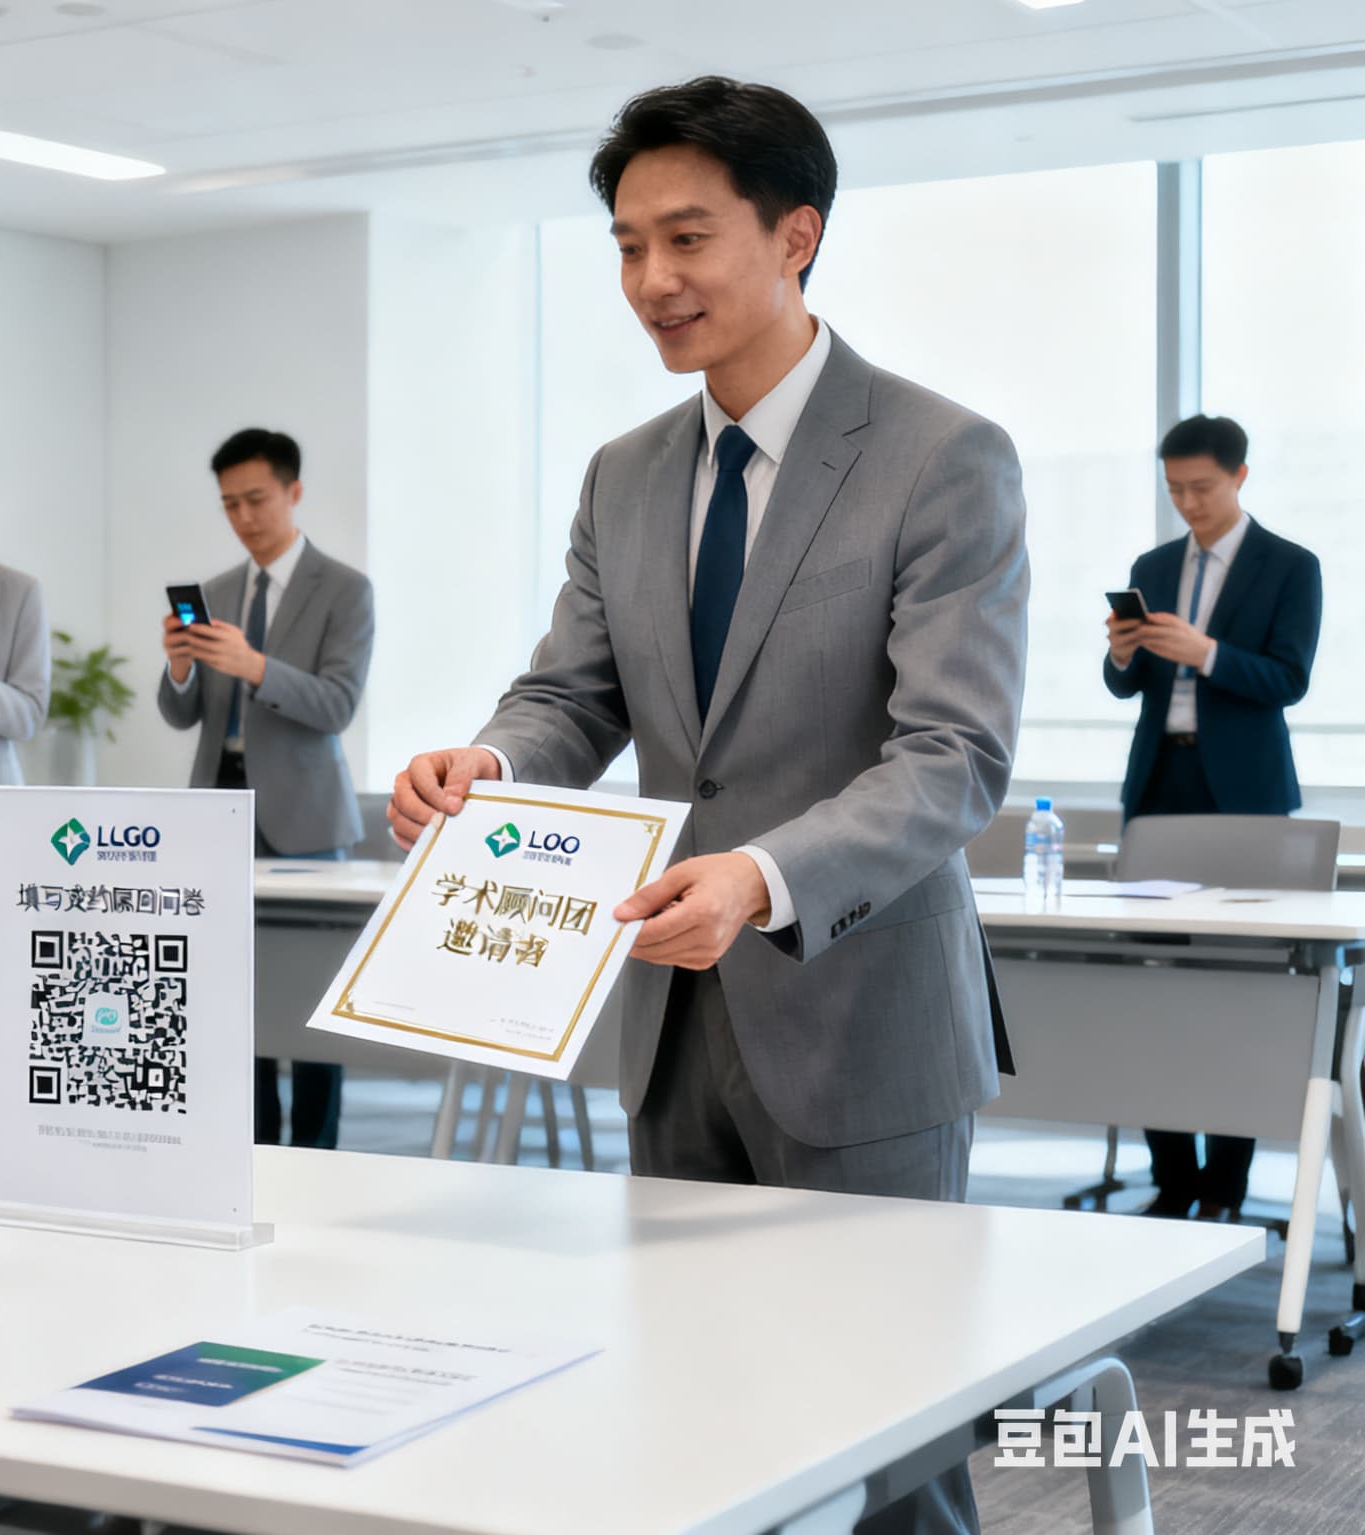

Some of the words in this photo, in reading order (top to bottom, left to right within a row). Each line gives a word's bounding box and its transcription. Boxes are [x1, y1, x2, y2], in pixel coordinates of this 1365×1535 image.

[97, 825, 161, 848] LLGO
[528, 830, 580, 854] LOO
[431, 873, 598, 936] 学术顾问团
